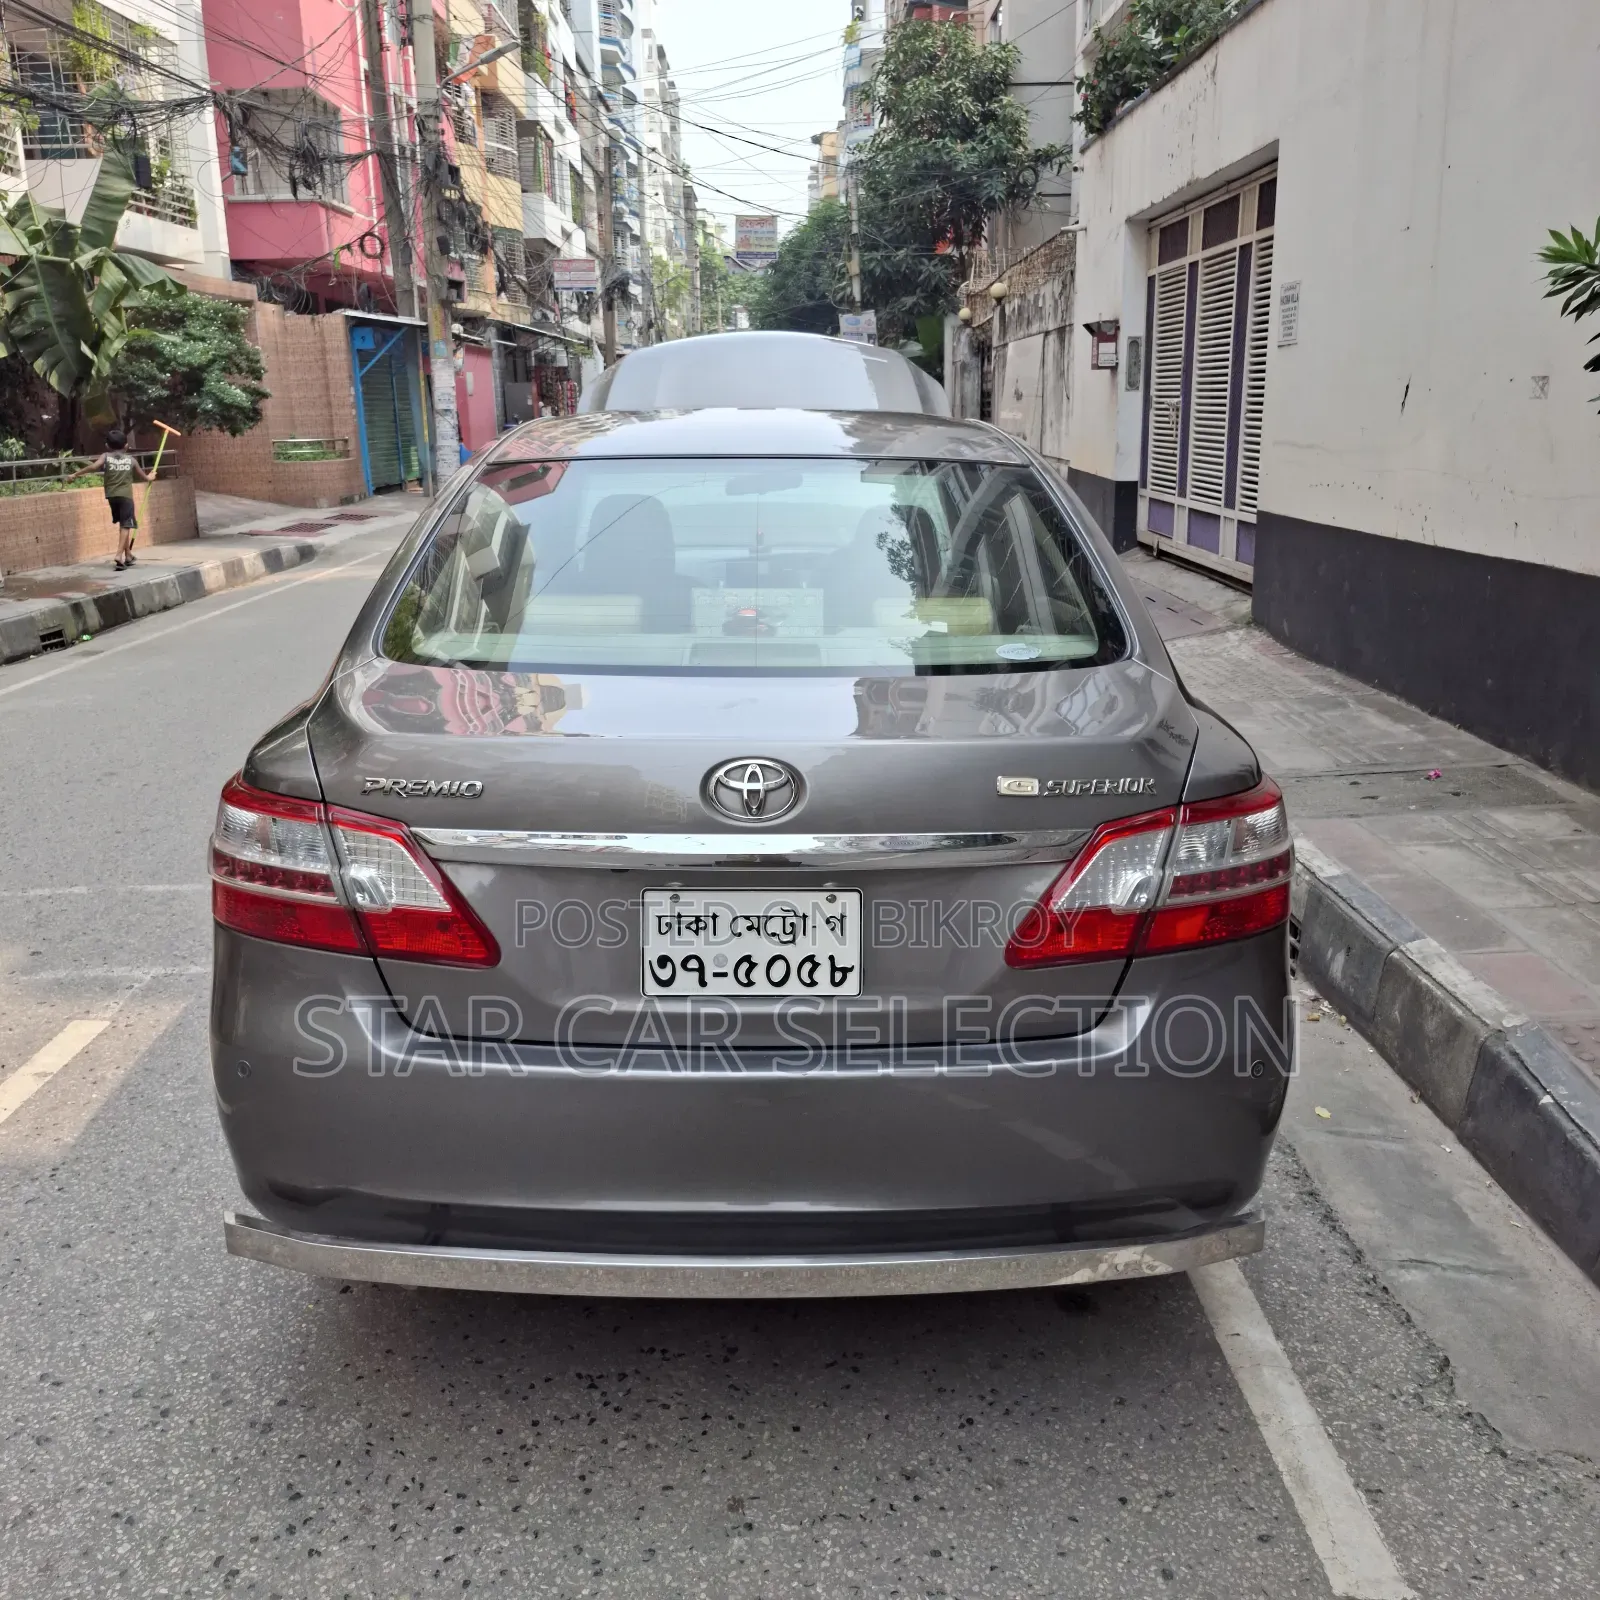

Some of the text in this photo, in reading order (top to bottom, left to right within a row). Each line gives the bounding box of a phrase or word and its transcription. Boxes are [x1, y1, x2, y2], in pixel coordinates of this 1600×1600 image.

[361, 777, 483, 798] PREMIO
[1044, 777, 1157, 796] SUPERIOR
[656, 912, 719, 937] ঢাকা
[649, 954, 854, 988] ৩৭-৫০৫৮
